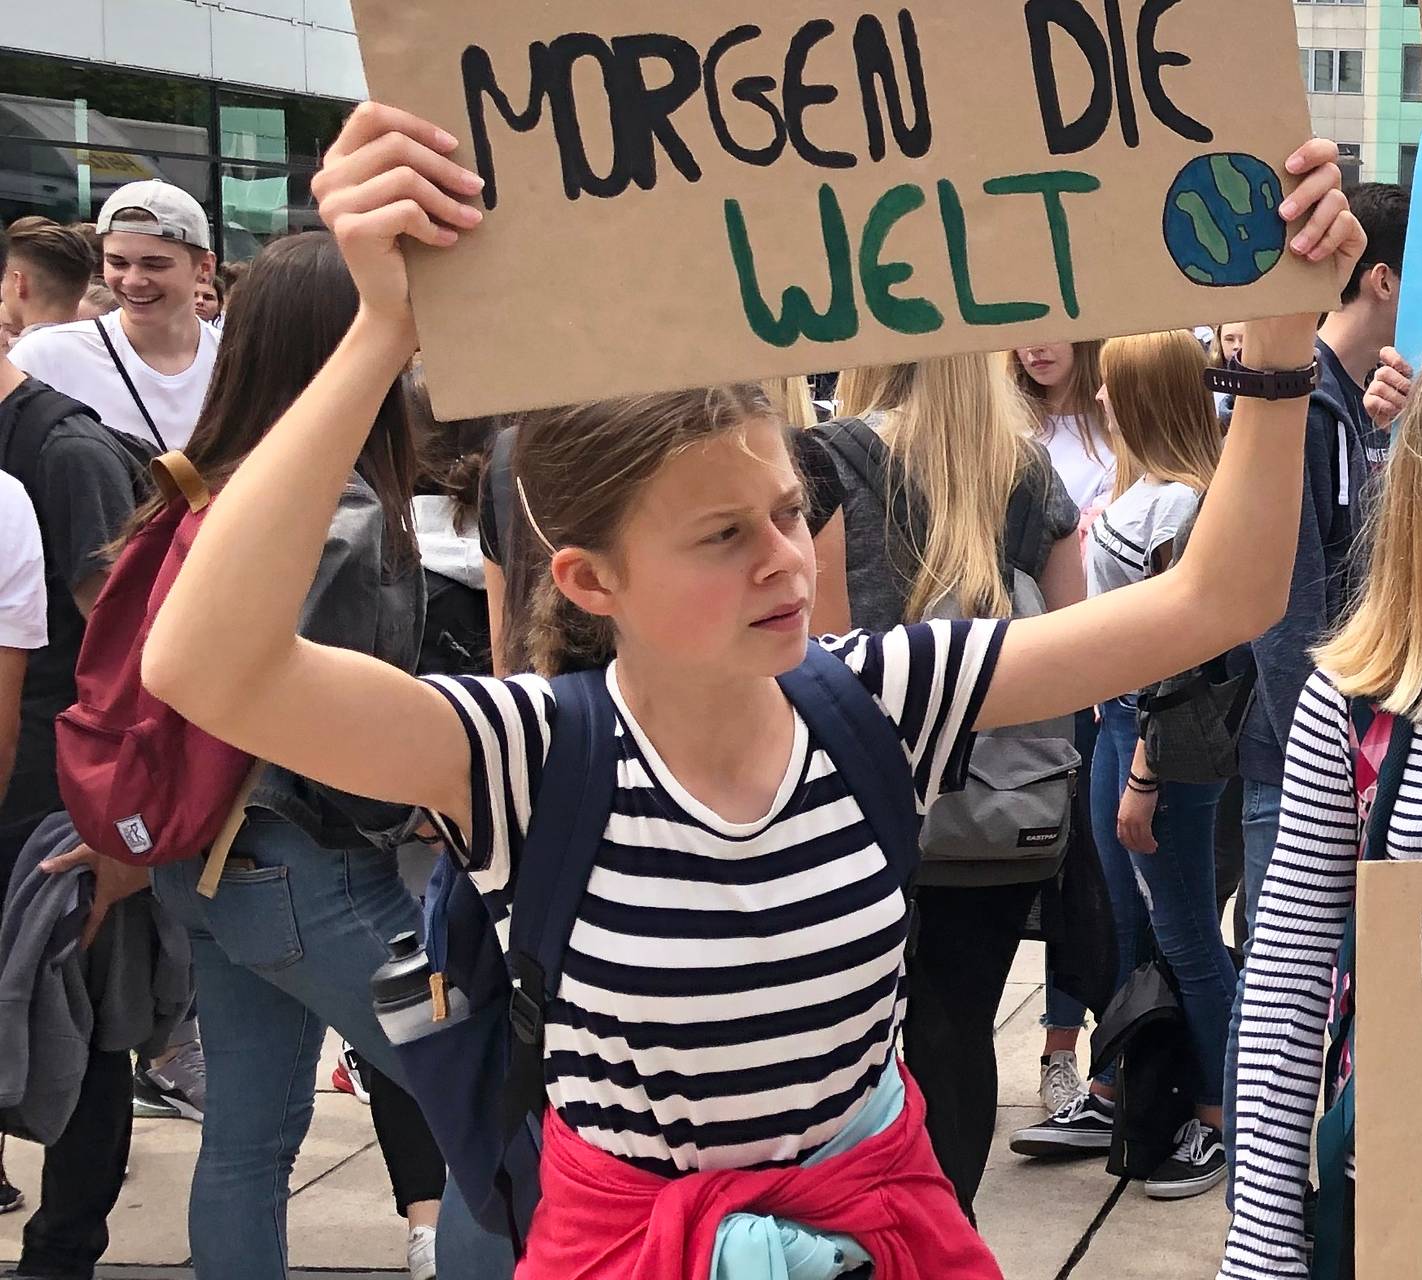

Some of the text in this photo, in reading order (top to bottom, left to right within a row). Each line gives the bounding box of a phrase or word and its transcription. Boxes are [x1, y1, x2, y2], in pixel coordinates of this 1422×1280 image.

[461, 0, 1214, 211] MORGEN DIE
[724, 170, 1101, 348] WELT
